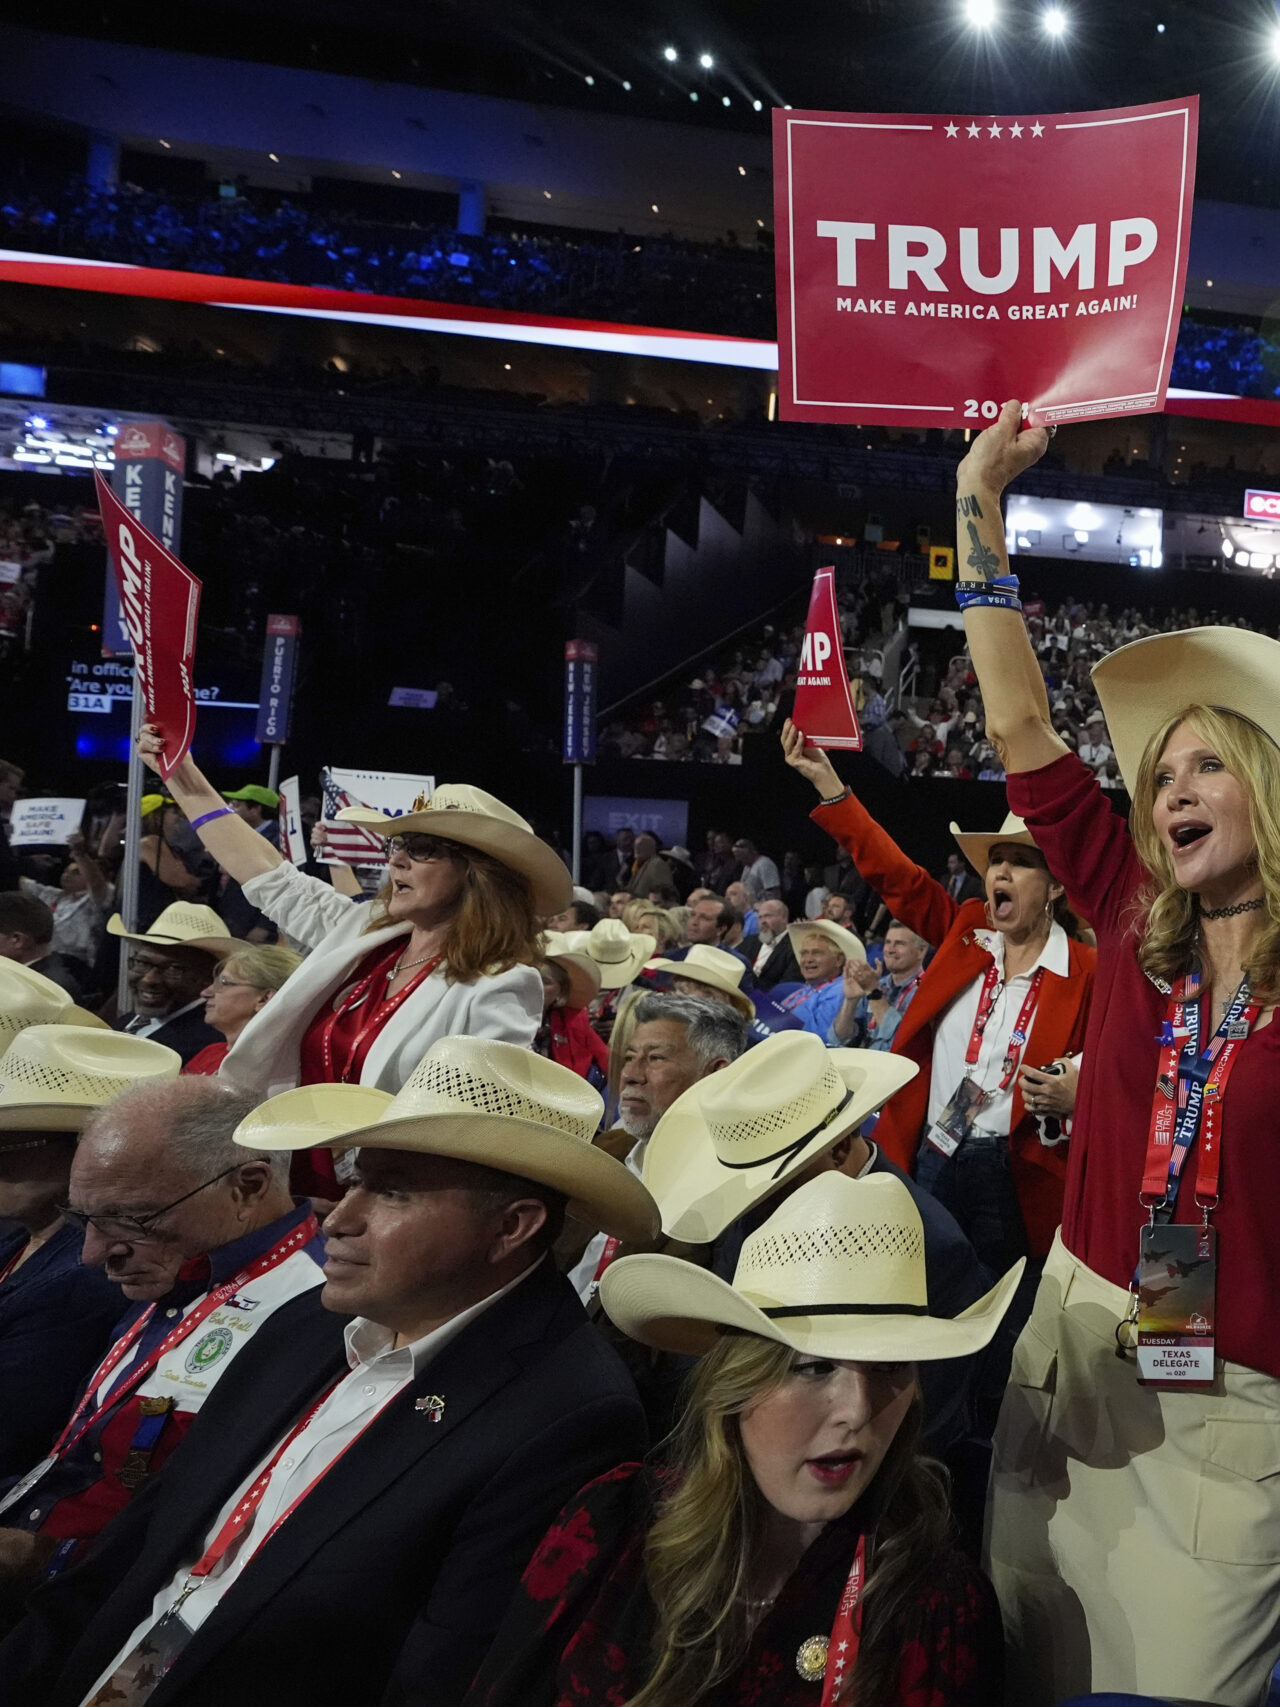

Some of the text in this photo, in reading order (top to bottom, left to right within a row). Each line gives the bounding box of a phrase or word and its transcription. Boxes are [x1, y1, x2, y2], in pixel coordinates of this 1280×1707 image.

[816, 217, 1159, 295] TRUMP
[836, 294, 1138, 320] MAKE AMERICA GREAT AGAIN!
[143, 559, 152, 602] AGAIN!
[987, 596, 1006, 604] USA
[72, 661, 88, 674] in
[145, 639, 155, 686] AMERICA
[179, 662, 192, 700] 2024
[266, 637, 285, 736] PUERTO RICO
[807, 676, 832, 686] AGAIN!
[69, 695, 105, 709] 31A
[608, 812, 663, 830] EXIT
[1219, 984, 1251, 1032] TRUMP
[1183, 1003, 1199, 1056] TRUMP
[1213, 1043, 1235, 1083] RNC2024
[1155, 1109, 1165, 1131] DATA
[1162, 1104, 1174, 1131] TRUST
[1179, 1081, 1203, 1139] TRUMP
[1198, 1242, 1210, 1257] 2
[208, 1311, 228, 1325] Bob
[1152, 1359, 1200, 1368] DELEGATE
[1162, 1350, 1191, 1358] TEXAS
[840, 1578, 852, 1617] TRUST
[848, 1575, 860, 1608] DATA
